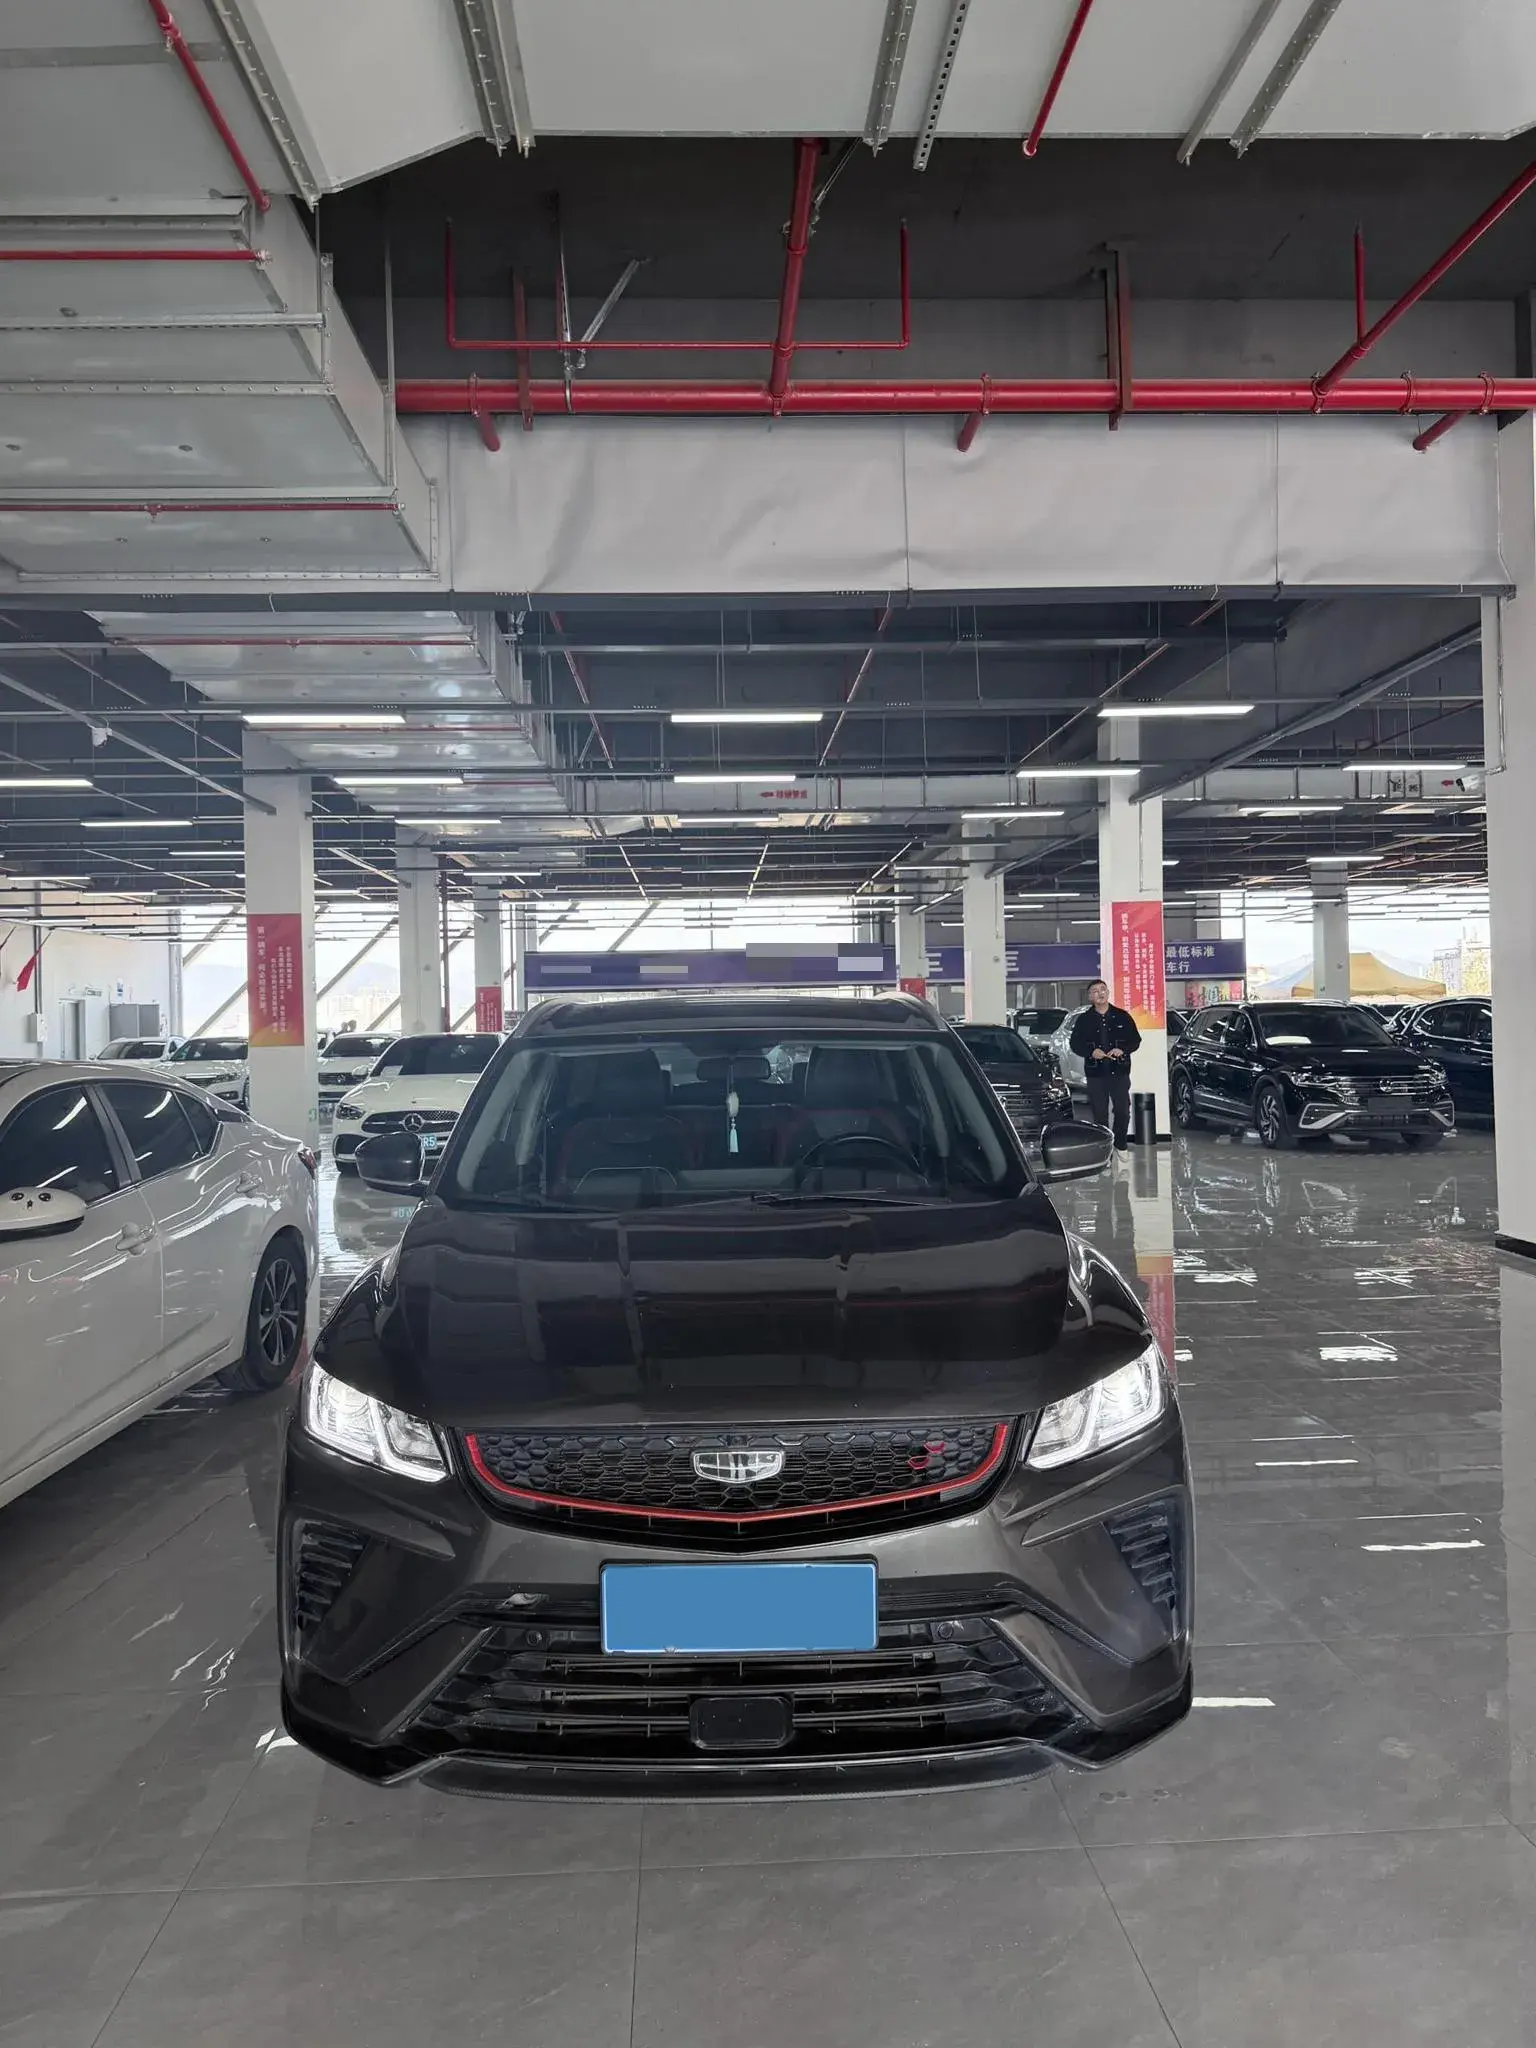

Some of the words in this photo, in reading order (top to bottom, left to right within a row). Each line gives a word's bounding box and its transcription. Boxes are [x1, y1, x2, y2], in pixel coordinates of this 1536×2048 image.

[1166, 946, 1215, 958] 最低标准
[1166, 961, 1190, 973] 车行
